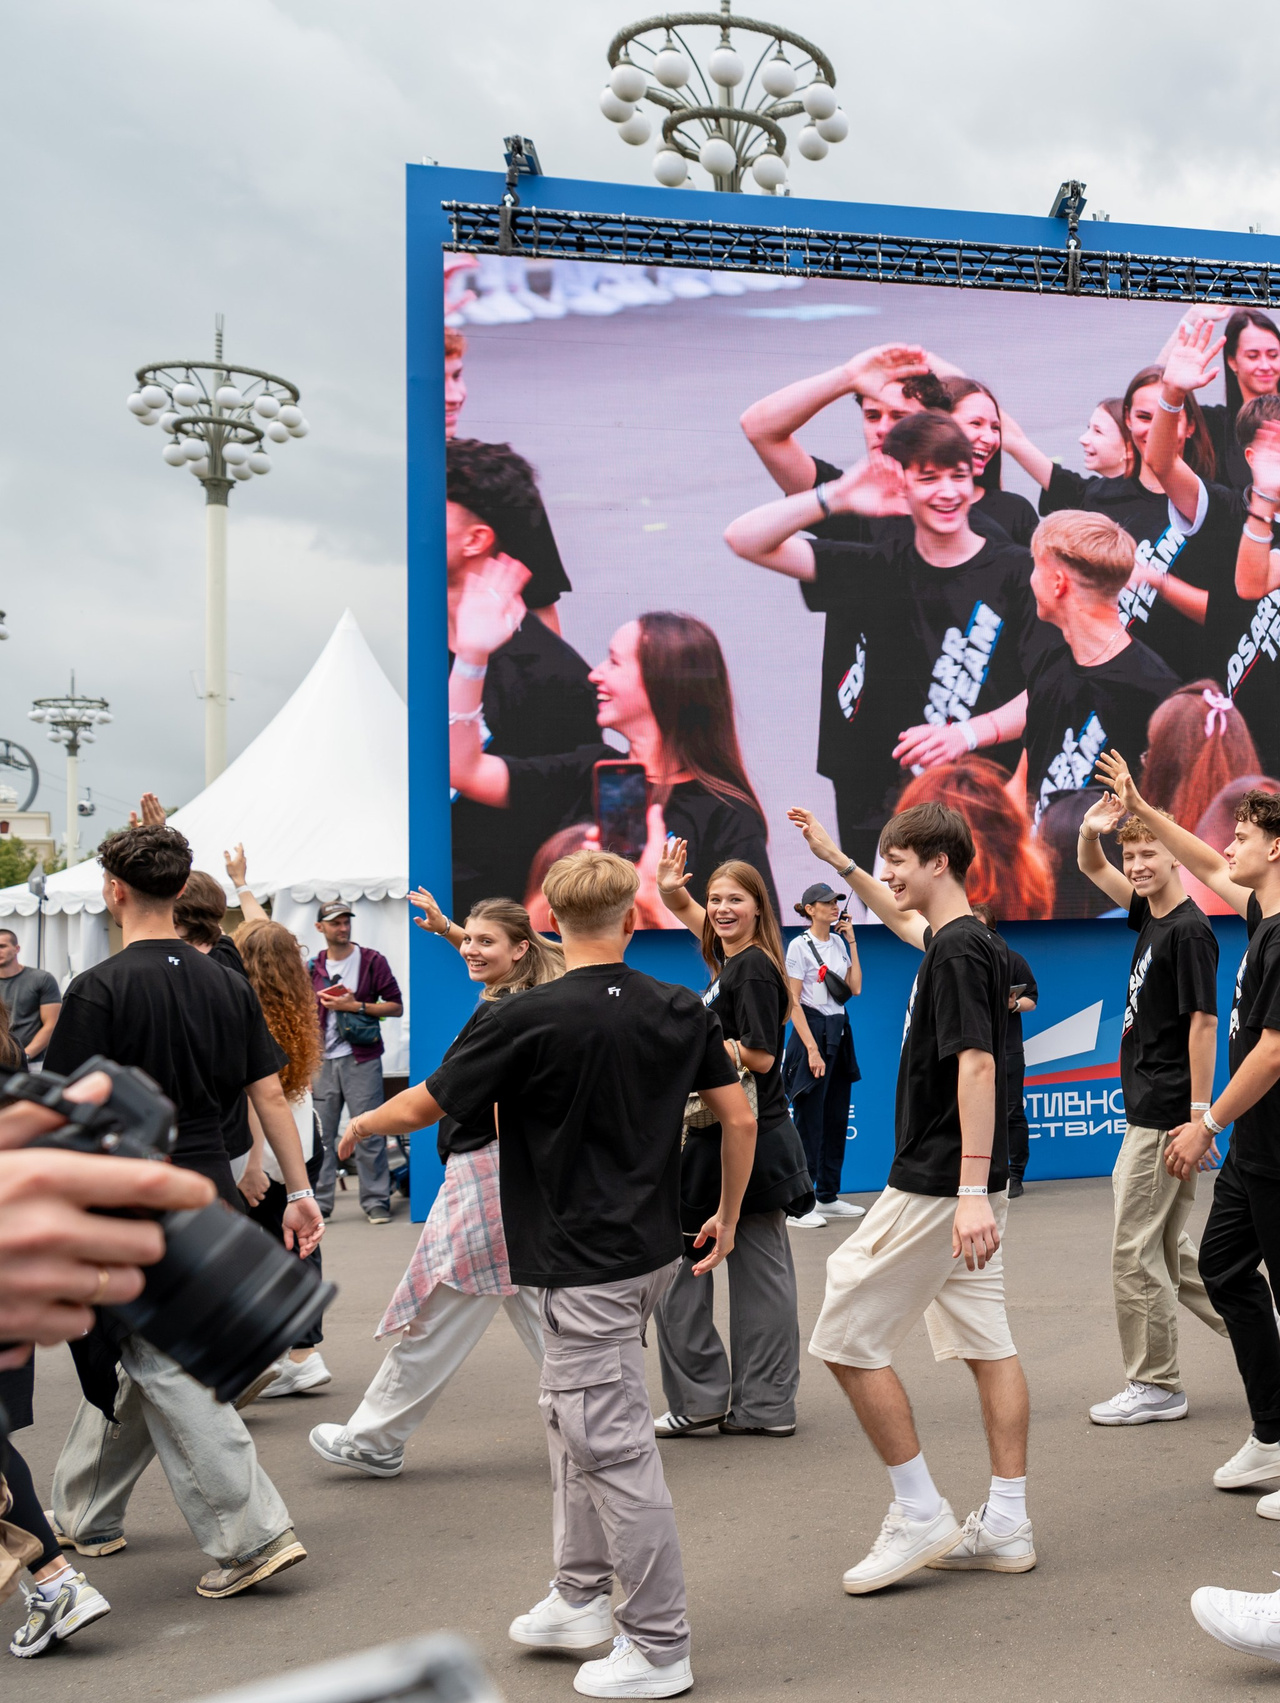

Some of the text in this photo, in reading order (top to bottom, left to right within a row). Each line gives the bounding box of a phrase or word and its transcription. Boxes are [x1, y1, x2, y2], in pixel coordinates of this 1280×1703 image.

[947, 603, 1002, 722] TEAM
[1023, 1088, 1126, 1118] ТИВНО
[1028, 1118, 1127, 1139] СТВИЕ
